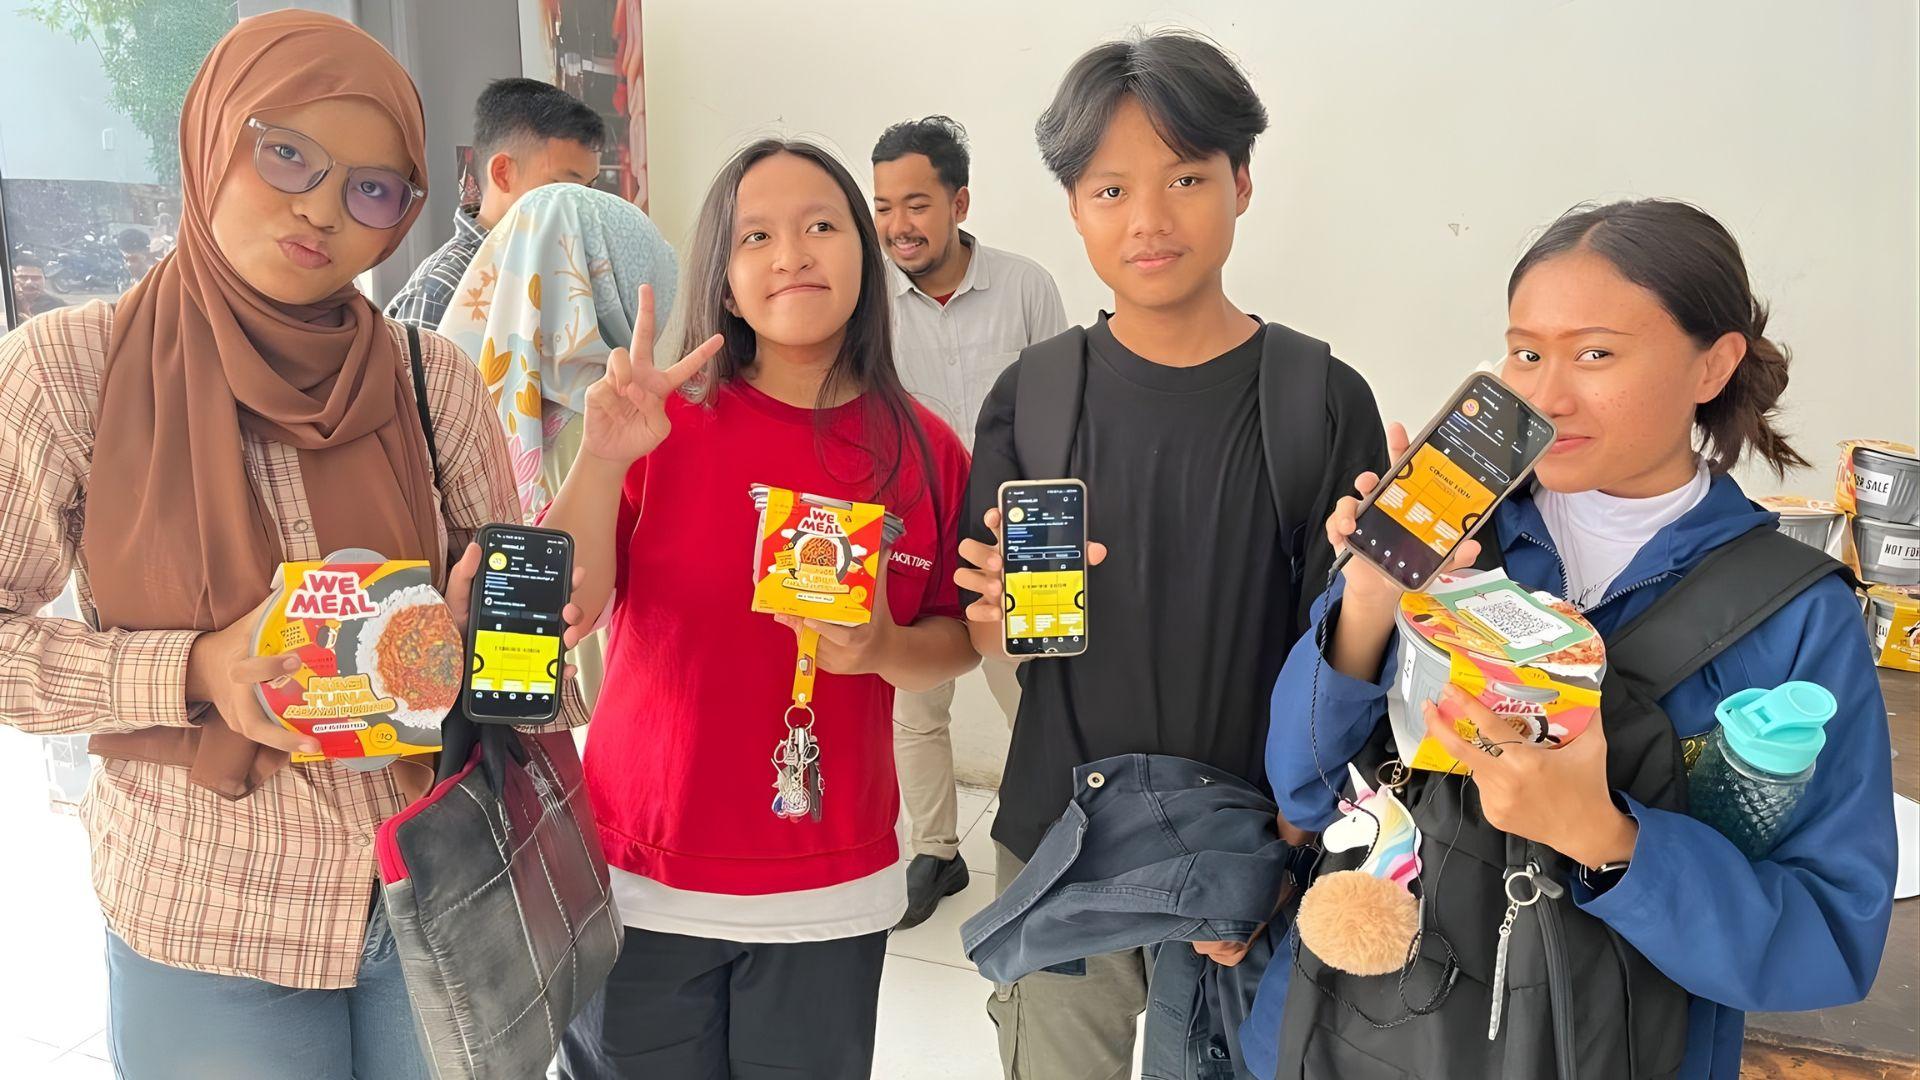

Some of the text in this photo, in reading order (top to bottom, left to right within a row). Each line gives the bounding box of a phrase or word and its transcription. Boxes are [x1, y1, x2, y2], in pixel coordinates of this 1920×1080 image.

[1866, 480, 1889, 494] SALE
[812, 510, 835, 524] WE
[802, 519, 843, 535] MEAL
[1885, 543, 1902, 556] NOT
[308, 573, 357, 595] WE
[290, 594, 376, 616] MEAL
[1493, 702, 1543, 714] MEAL
